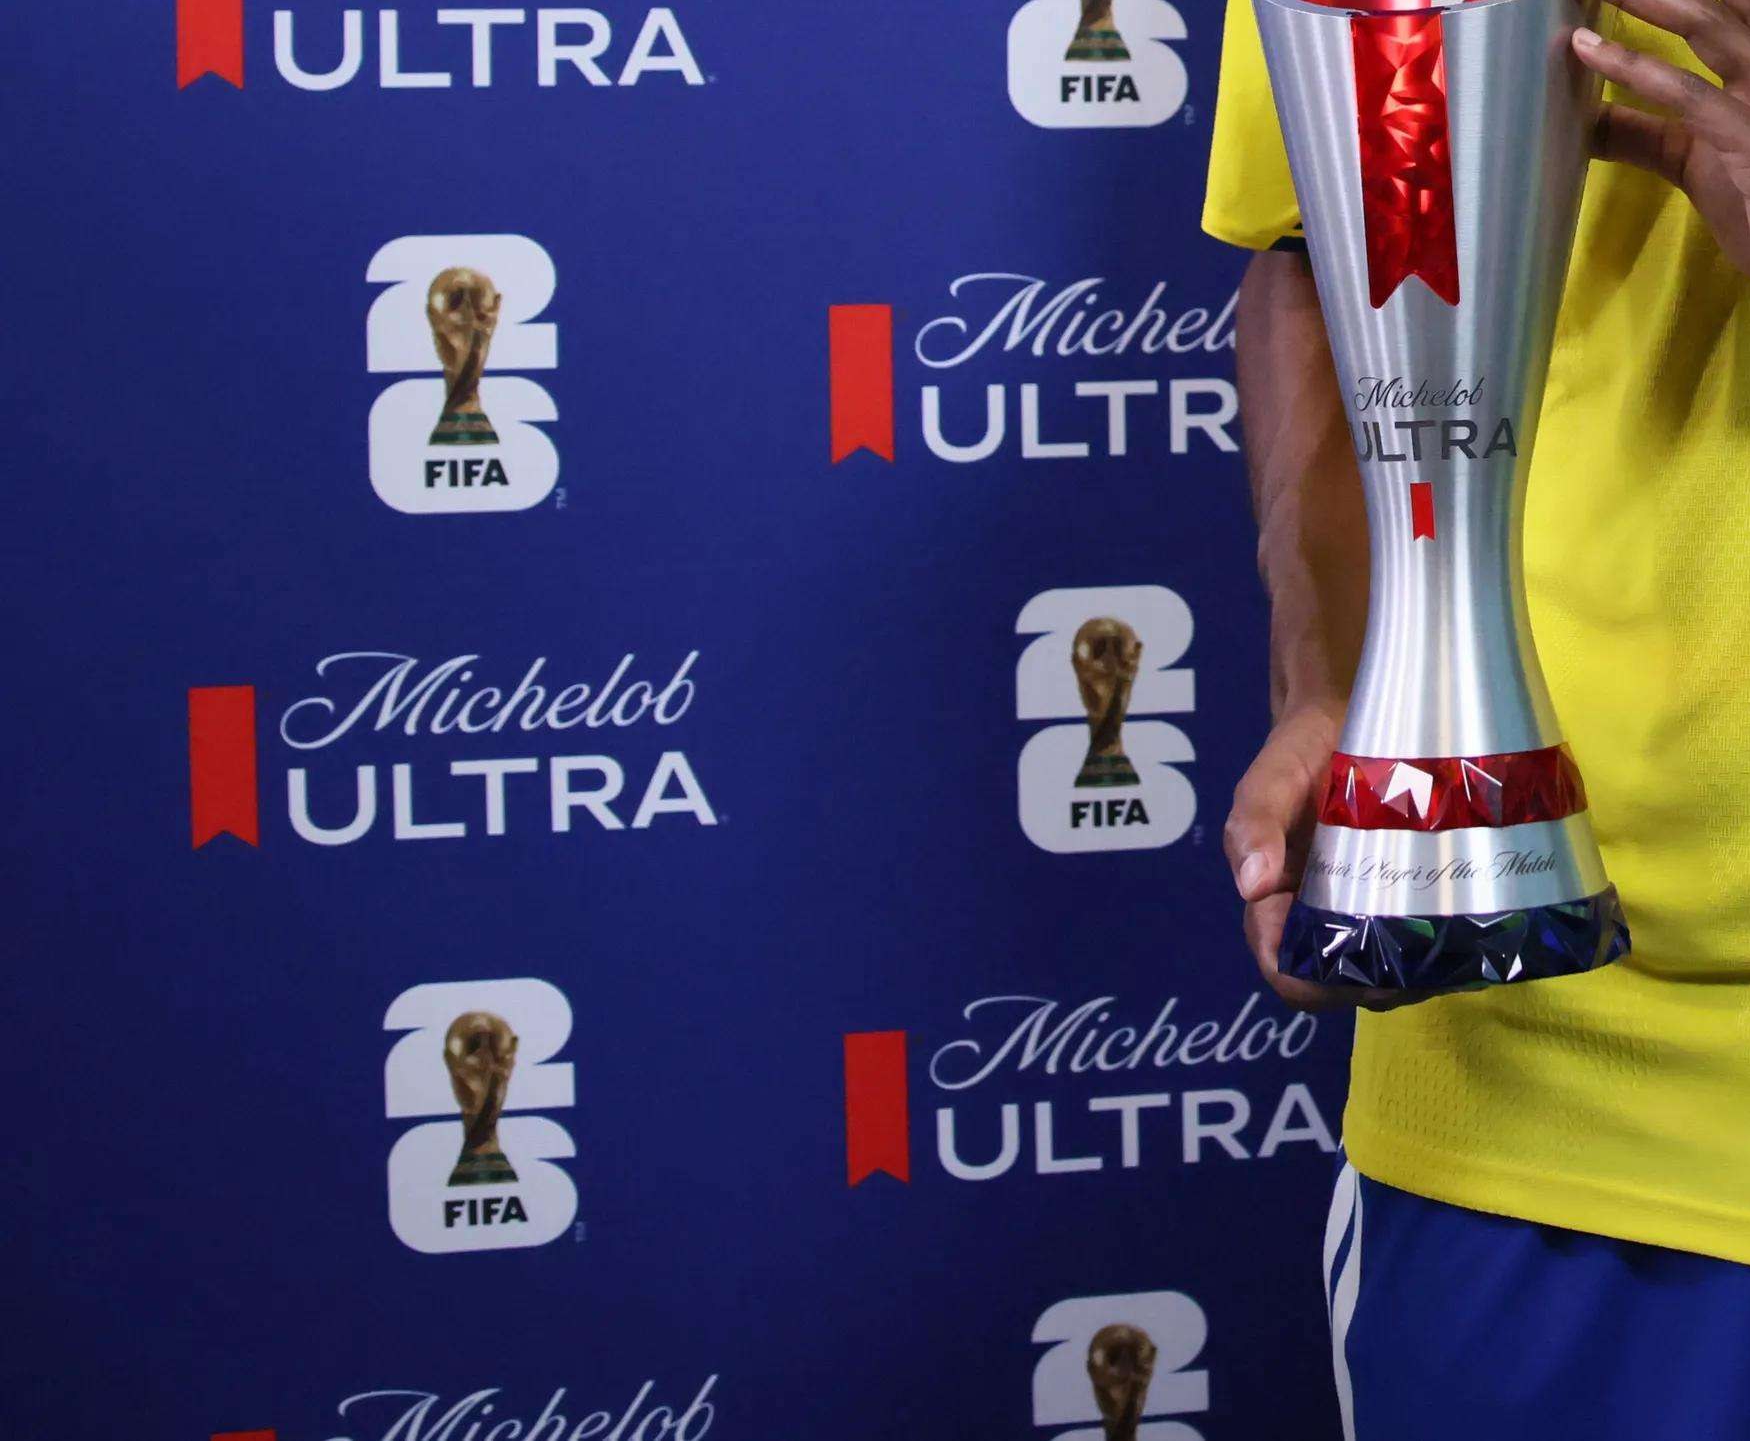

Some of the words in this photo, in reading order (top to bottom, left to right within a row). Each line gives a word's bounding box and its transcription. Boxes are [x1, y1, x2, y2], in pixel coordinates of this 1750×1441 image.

[274, 8, 705, 90] ULTRA
[1062, 75, 1140, 102] FIFA
[915, 273, 1240, 368] Michel
[922, 379, 1238, 462] ULTR
[1354, 376, 1485, 411] Michelob
[426, 459, 509, 487] FIFA
[281, 651, 698, 749] Michelob
[288, 752, 717, 845] ULTRA
[1072, 799, 1149, 828] FIFA
[937, 1084, 1336, 1180] ULTRA
[445, 1197, 528, 1227] FIFA
